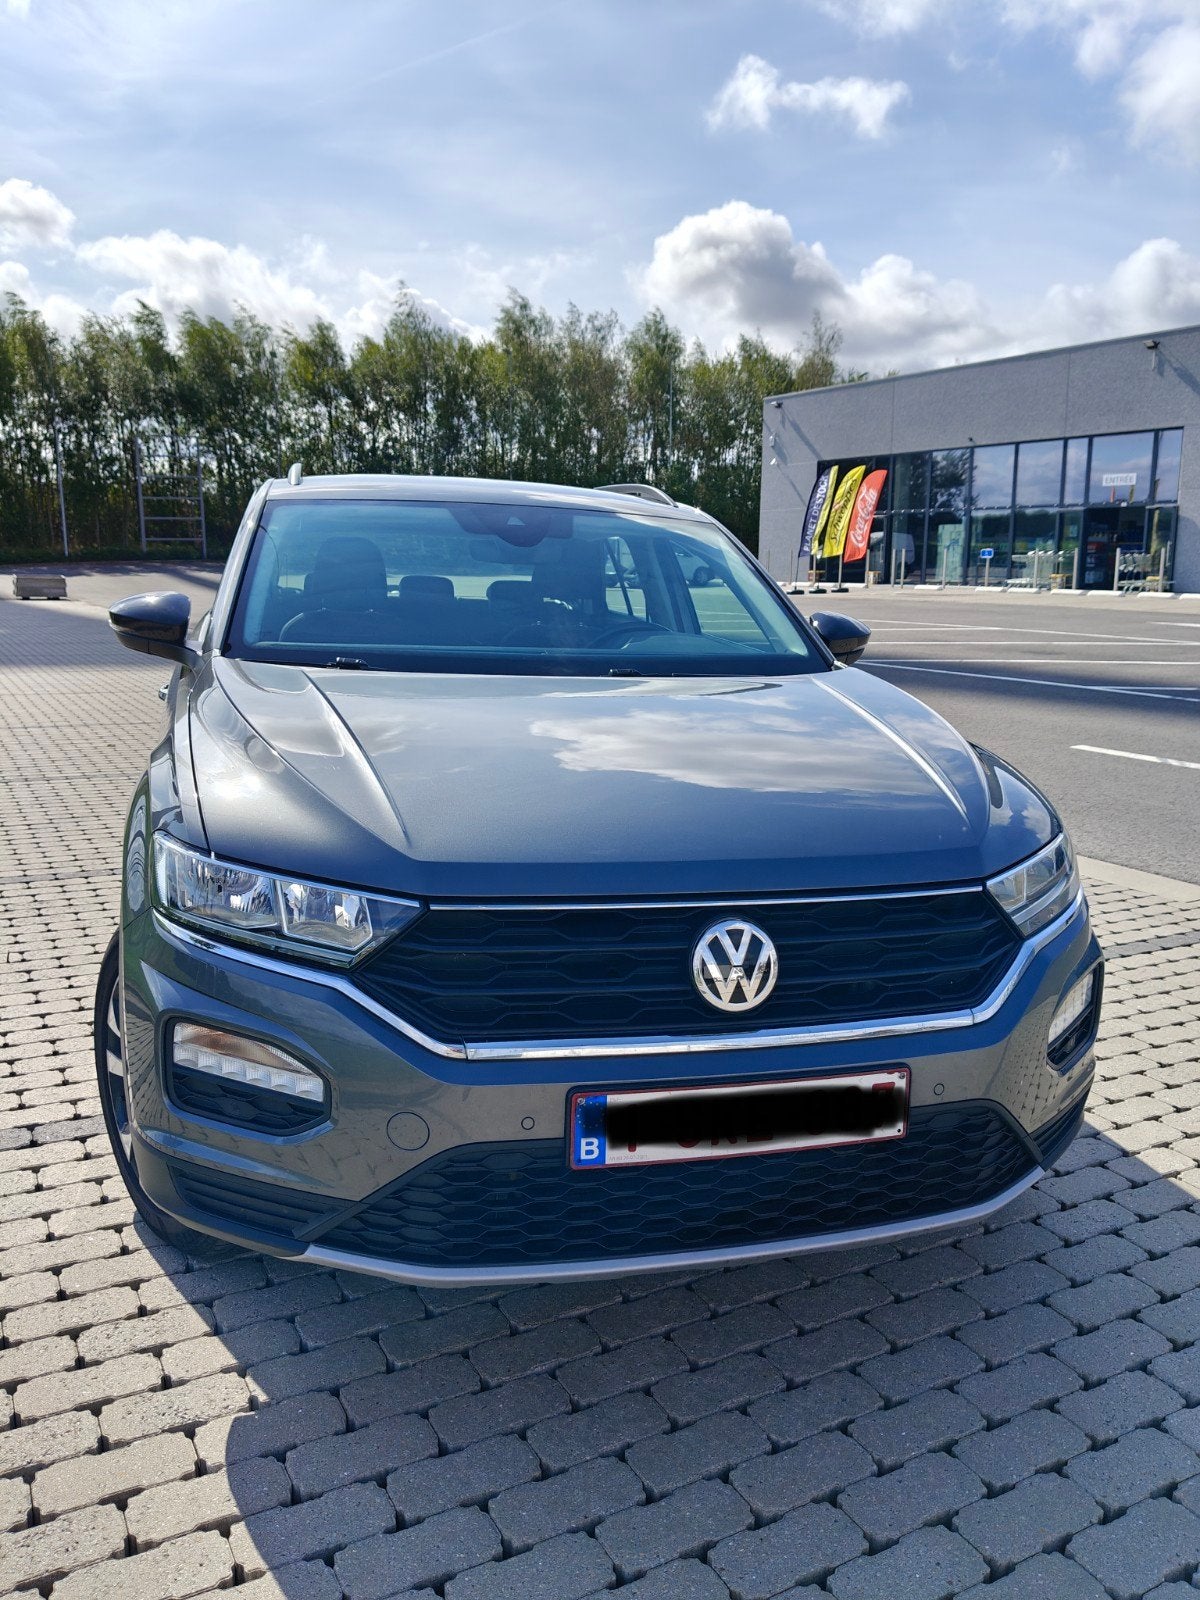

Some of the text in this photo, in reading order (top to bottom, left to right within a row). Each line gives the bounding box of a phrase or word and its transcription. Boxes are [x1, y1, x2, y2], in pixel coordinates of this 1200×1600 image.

[830, 478, 857, 545] Schweppes
[803, 518, 817, 552] PLANET
[581, 1138, 600, 1160] B
